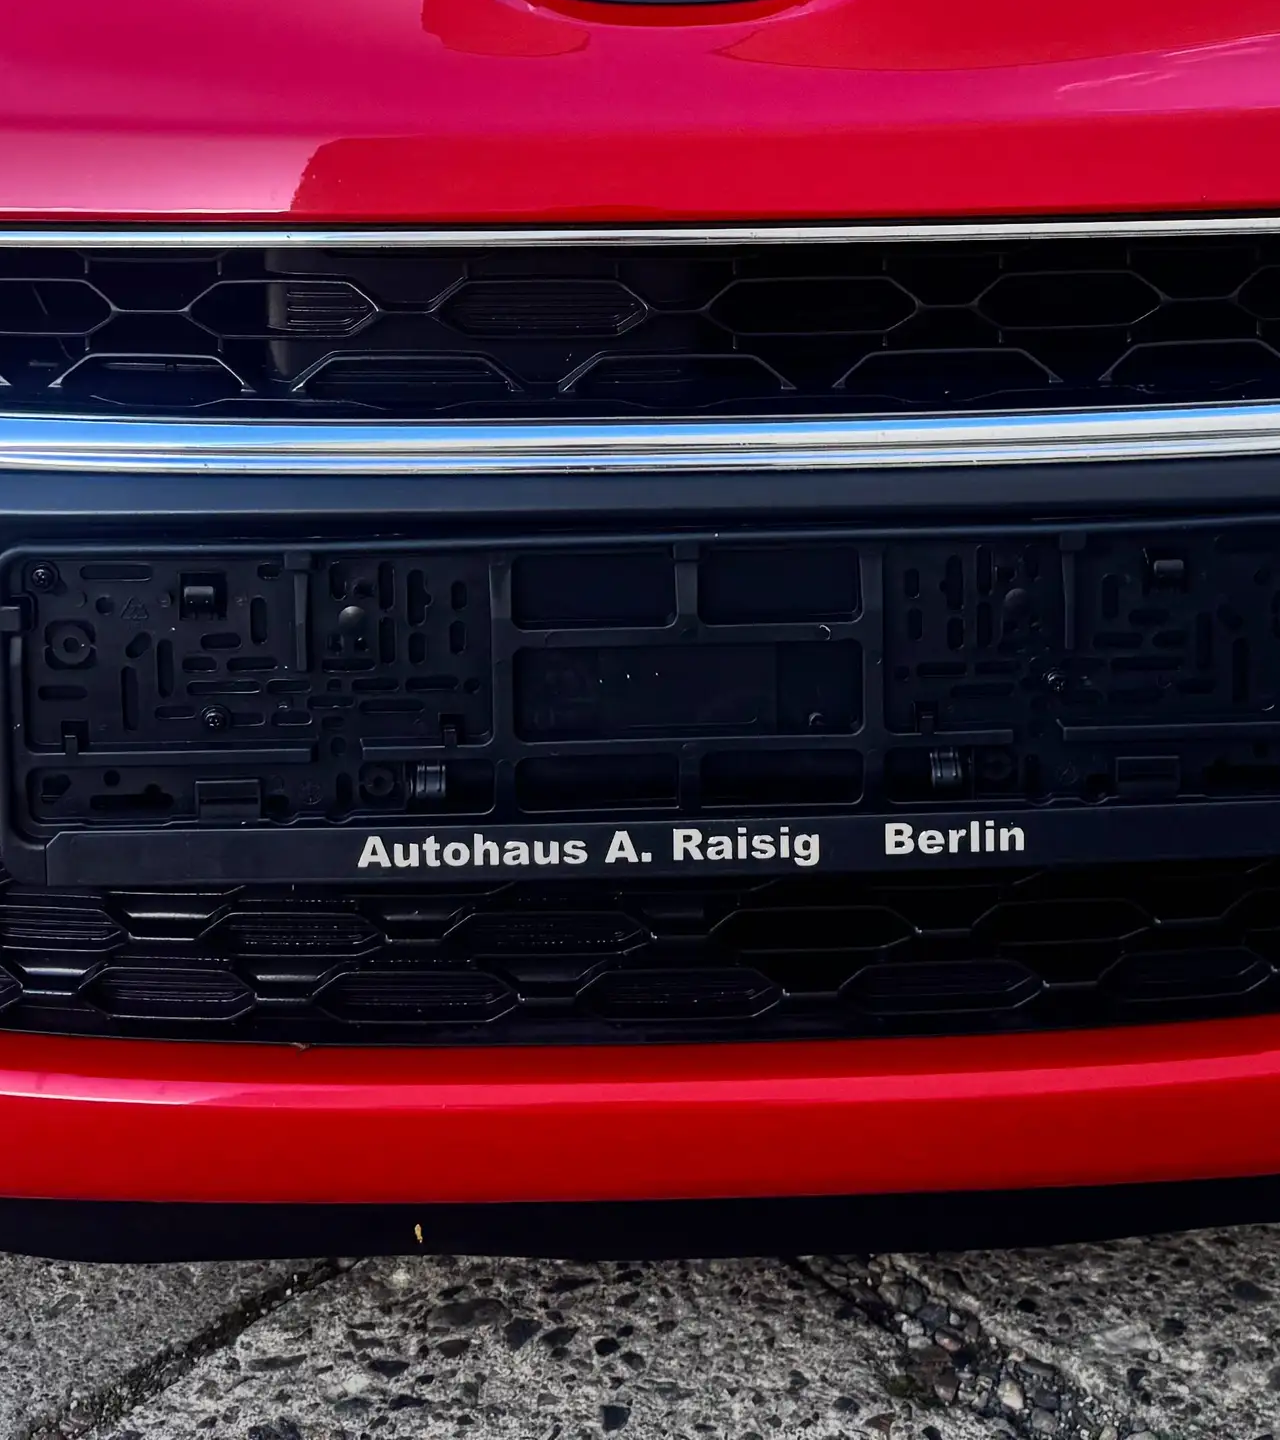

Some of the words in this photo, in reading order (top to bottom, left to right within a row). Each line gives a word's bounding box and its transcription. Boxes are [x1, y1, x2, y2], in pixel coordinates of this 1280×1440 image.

[357, 833, 589, 868] Autohaus
[604, 831, 653, 863] A.
[672, 825, 821, 866] Raisig
[884, 820, 1026, 856] Berlin
